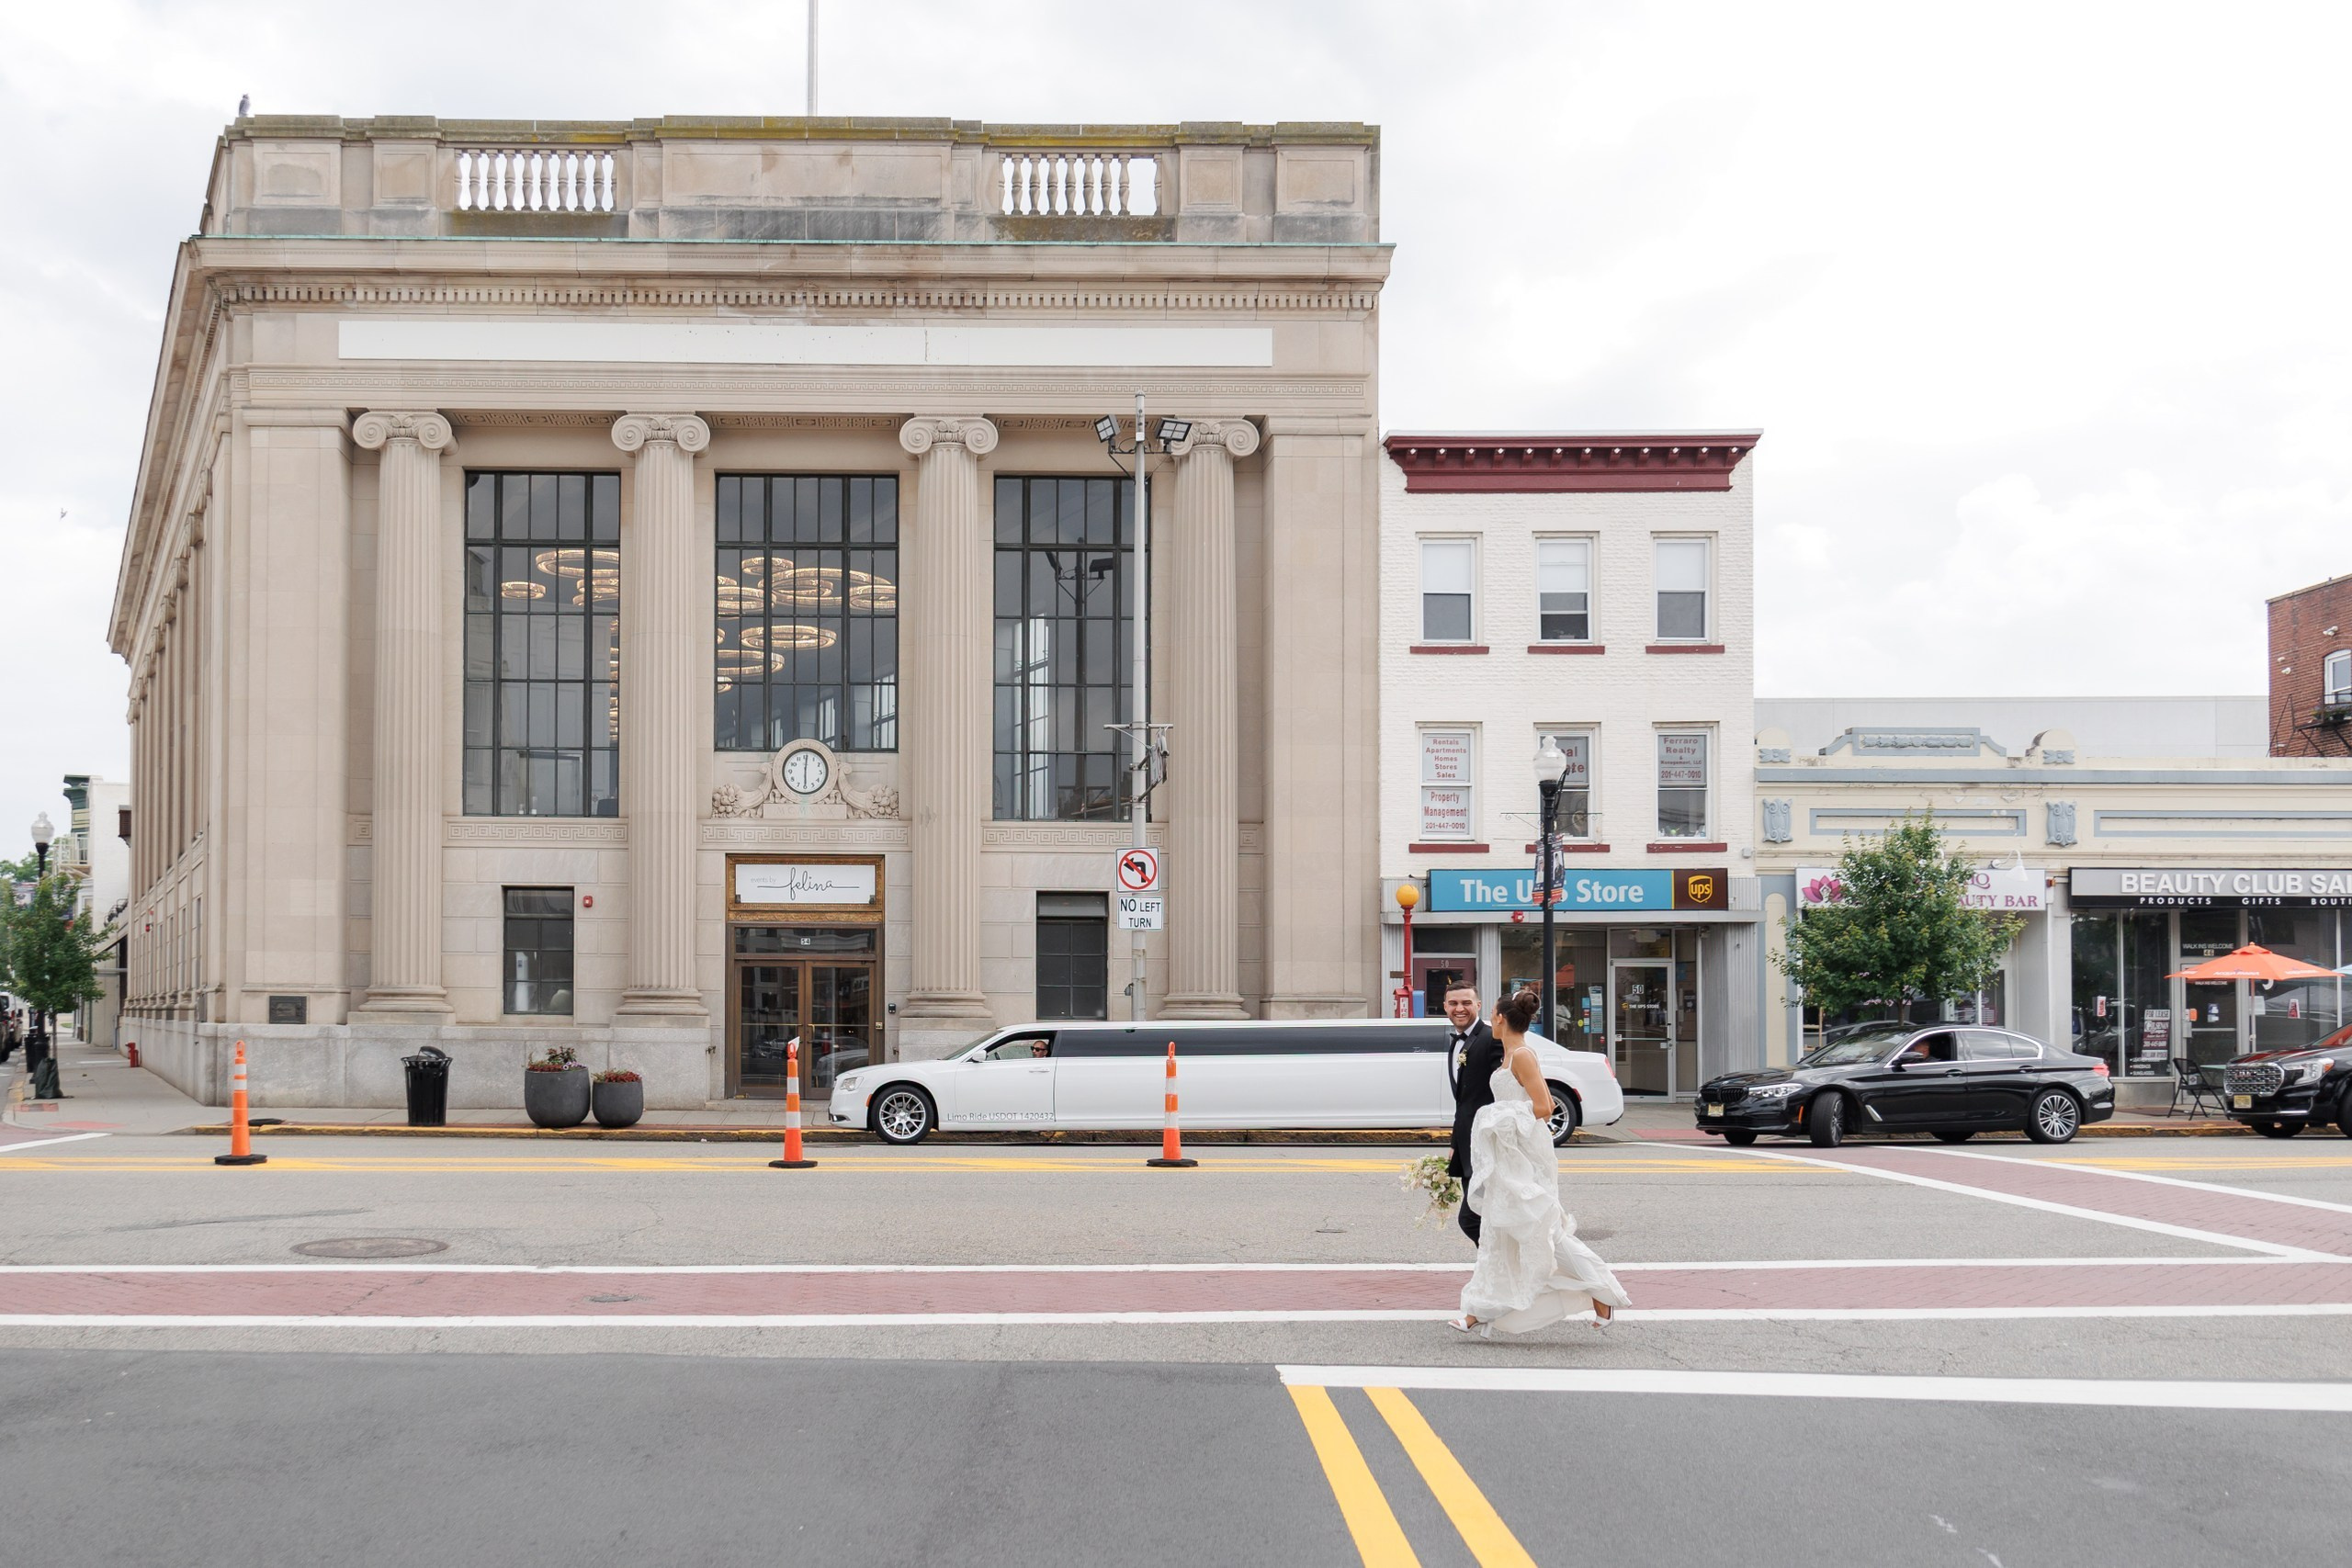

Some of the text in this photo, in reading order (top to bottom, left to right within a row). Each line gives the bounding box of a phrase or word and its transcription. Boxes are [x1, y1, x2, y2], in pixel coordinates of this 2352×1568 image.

[1666, 746, 1696, 754] Realty
[1430, 791, 1460, 804] Property
[1424, 806, 1467, 818] Management
[2120, 874, 2226, 894] BEAUTY
[2233, 874, 2303, 894] CLUB
[1460, 879, 1508, 903] The
[1576, 878, 1644, 903] Store
[1120, 898, 1161, 912] NO LEFT
[2004, 895, 2038, 907] BAR
[2140, 897, 2211, 905] PRODUCTS
[1128, 917, 1151, 928] TURN
[1441, 959, 1450, 968] 50
[1633, 985, 1643, 994] 50
[947, 1112, 1054, 1121] Limo Ride USDOT 1420432
